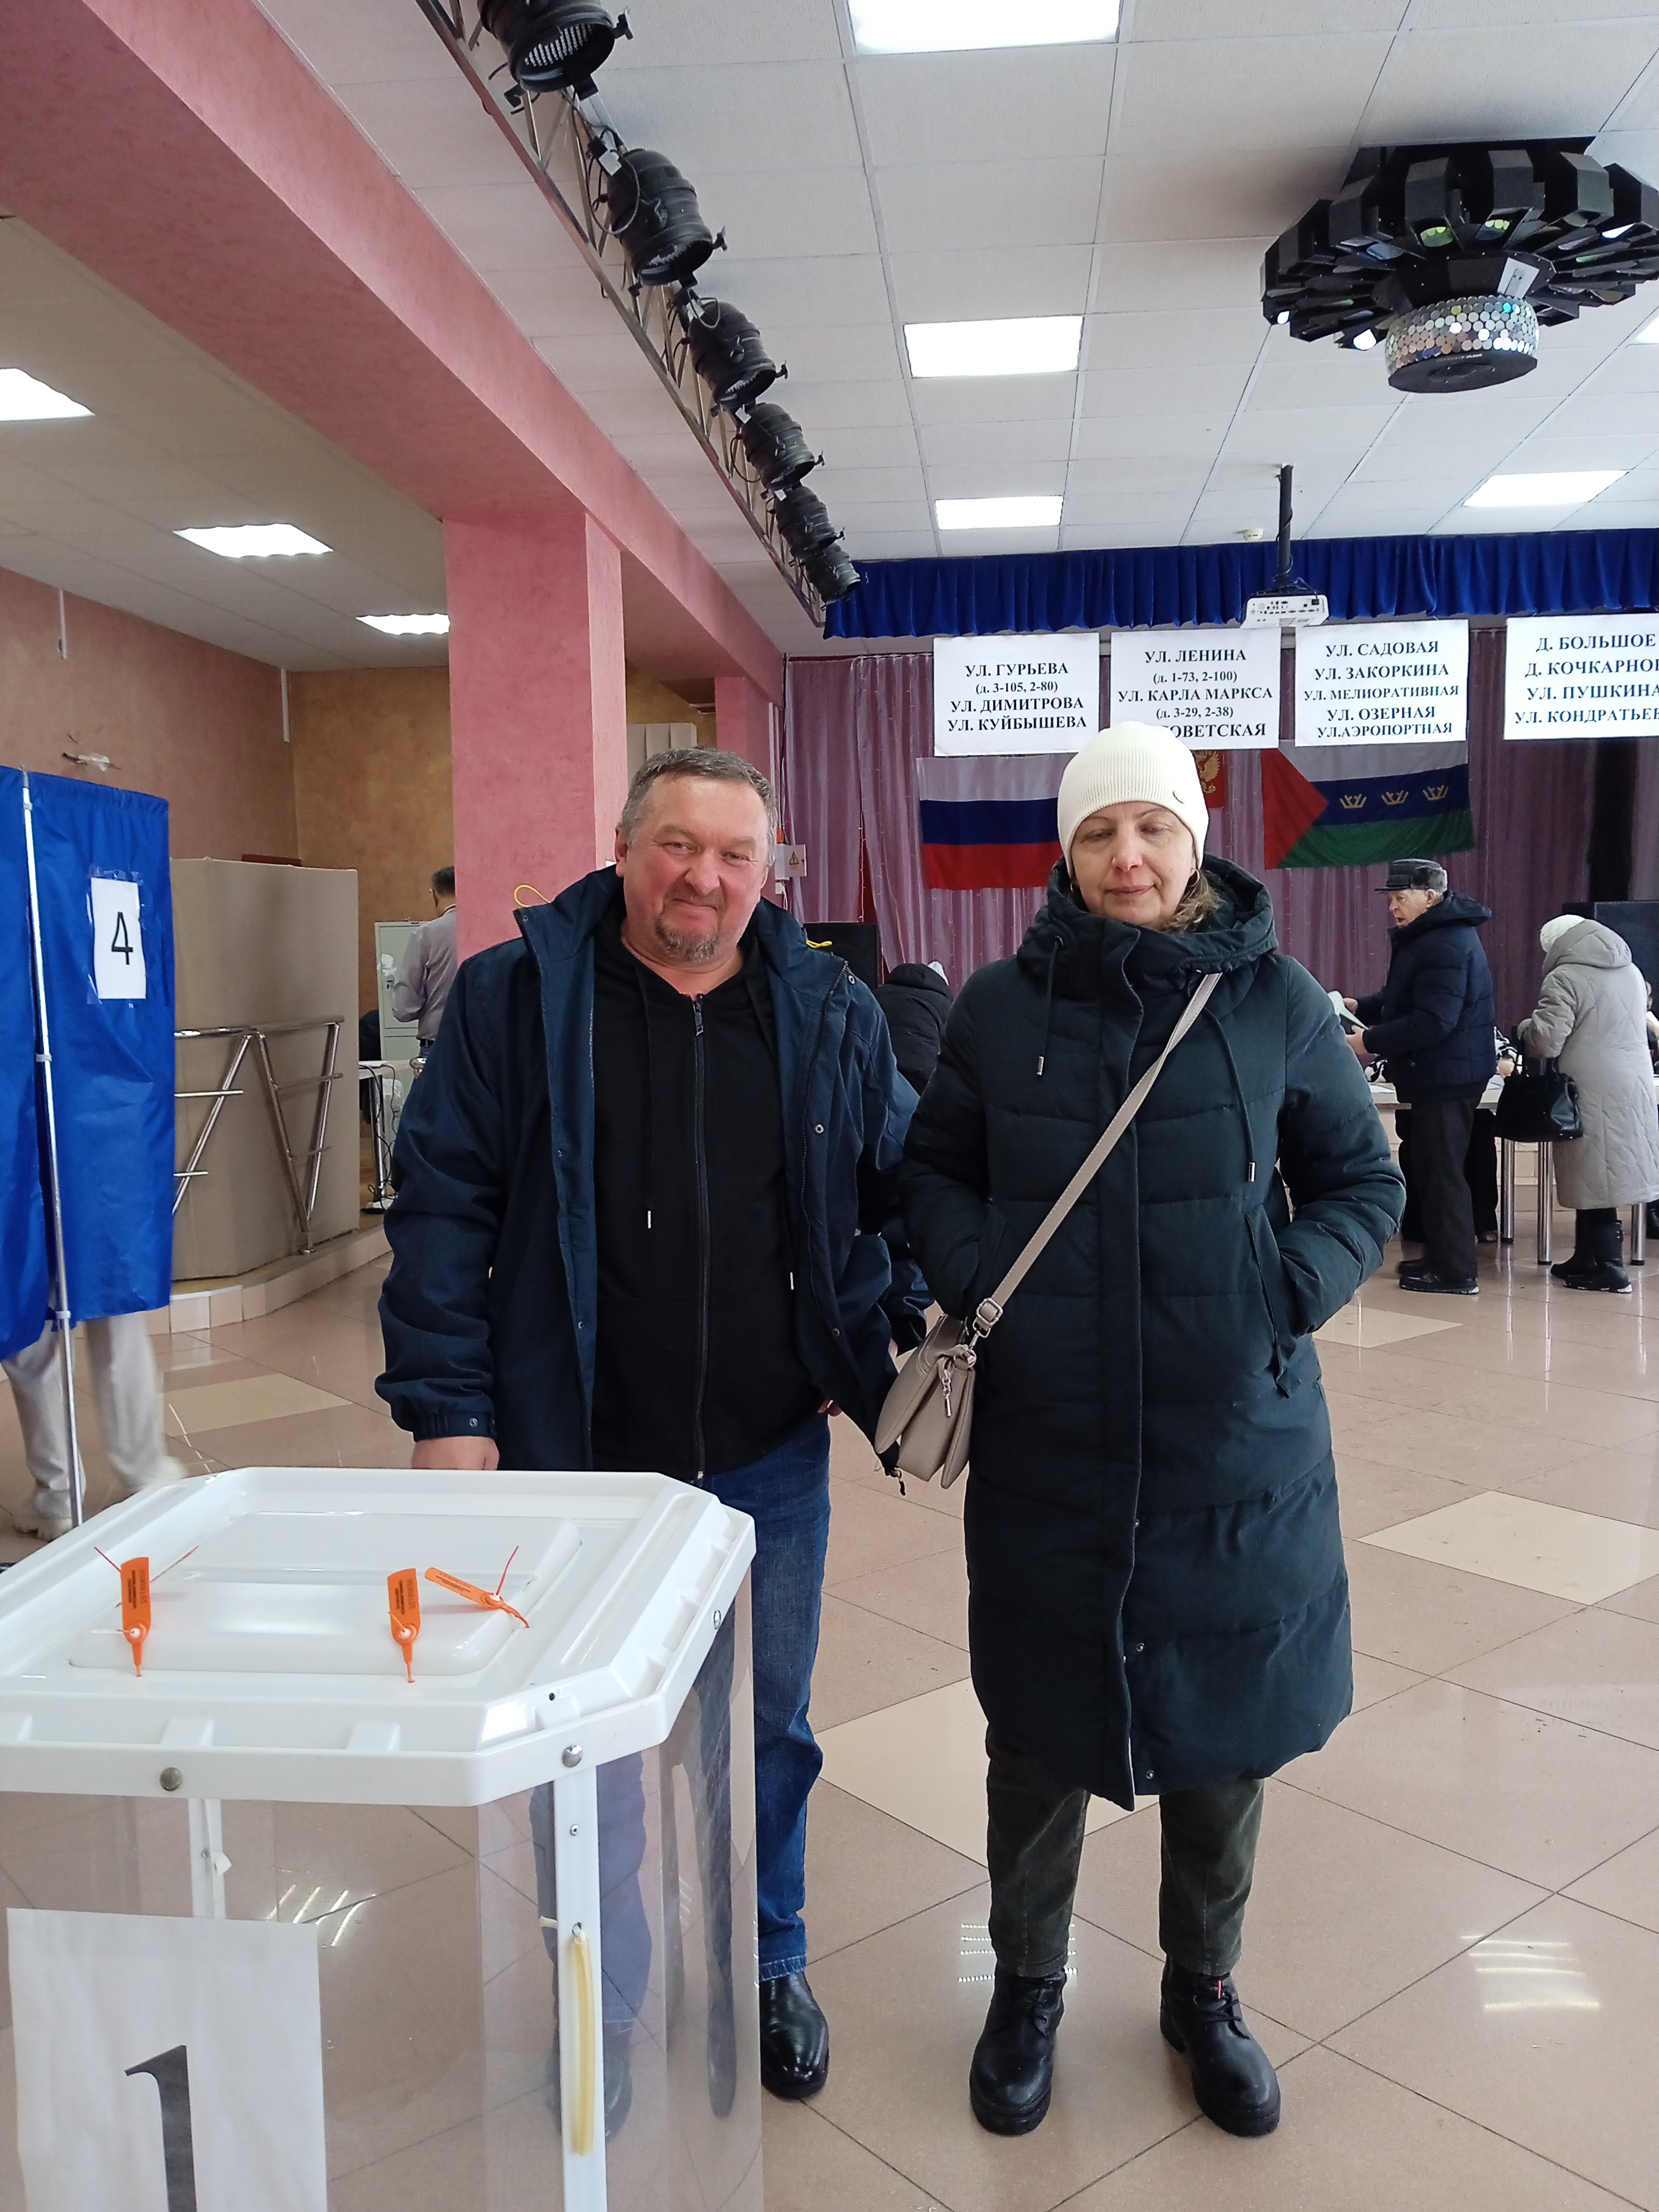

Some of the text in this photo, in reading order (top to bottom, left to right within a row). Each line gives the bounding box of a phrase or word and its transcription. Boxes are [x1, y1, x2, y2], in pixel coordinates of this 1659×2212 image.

[1326, 641, 1438, 657] УЛ. САДОВАЯ
[1536, 634, 1656, 652] Д. БОЛЬШОЕ
[1145, 649, 1246, 663] УЛ. ЛЕНИНА
[965, 663, 1068, 677] УЛ. ГУРЬЕВА
[1314, 664, 1448, 680] УЛ. ЗАКОРКИНА
[1525, 664, 1541, 677] Д.
[1153, 671, 1237, 684] (д. 1-73, 2-100)
[976, 682, 1058, 694] (д. 3-105, 2-80)
[1118, 688, 1272, 702] УЛ. КАРЛА МАРКСА
[1304, 685, 1458, 700] УЛ. МЕЛИОРАТИВНАЯ
[1527, 684, 1659, 700] УЛ. ПУШКИНА
[951, 697, 1083, 714] УЛ. ДИМИТРОВА
[1157, 707, 1233, 719] (д. 3-29, 2-38)
[1327, 707, 1435, 721] УЛ. ОЗЕРНАЯ
[1515, 712, 1541, 724] УЛ.
[948, 715, 1086, 731] УЛ. КУЙБЫШЕВА
[1162, 724, 1266, 738] ОВЕТСКАЯ
[112, 911, 133, 965] 4
[124, 2045, 198, 2212] 1
